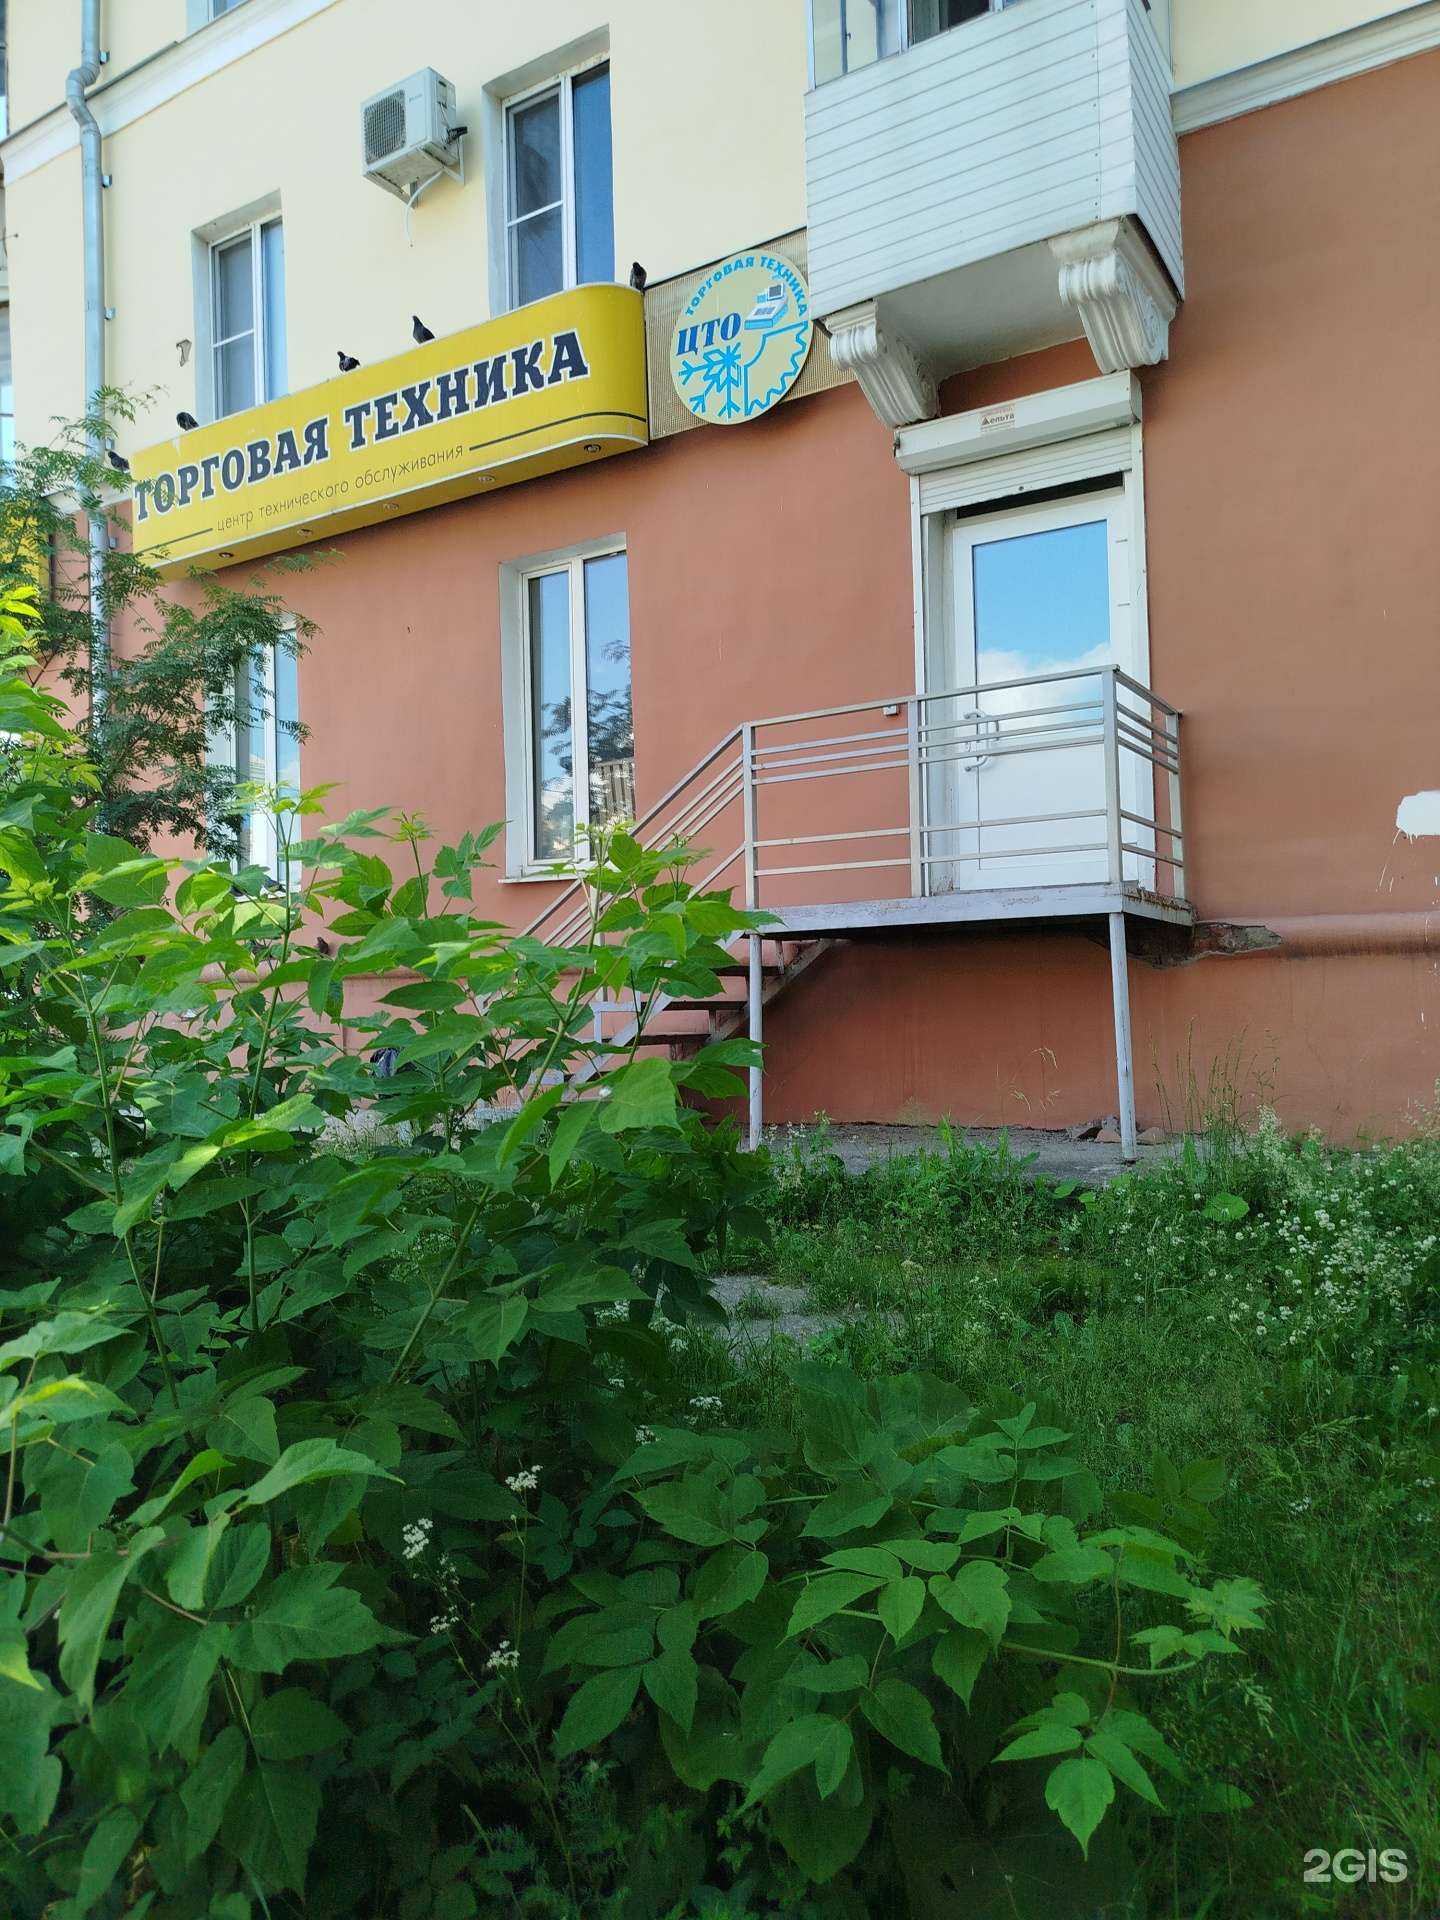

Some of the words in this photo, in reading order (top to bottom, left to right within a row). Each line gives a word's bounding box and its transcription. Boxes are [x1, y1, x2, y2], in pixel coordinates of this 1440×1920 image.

[685, 256, 755, 316] ТОРГОВАЯ
[760, 256, 808, 316] ТЕХНИКА
[676, 312, 742, 356] ЦТО
[134, 417, 329, 521] ТОРГОВАЯ
[344, 330, 589, 449] ТЕХНИКА
[217, 510, 253, 530] центр
[259, 480, 349, 517] технического
[355, 445, 463, 489] обслуживания
